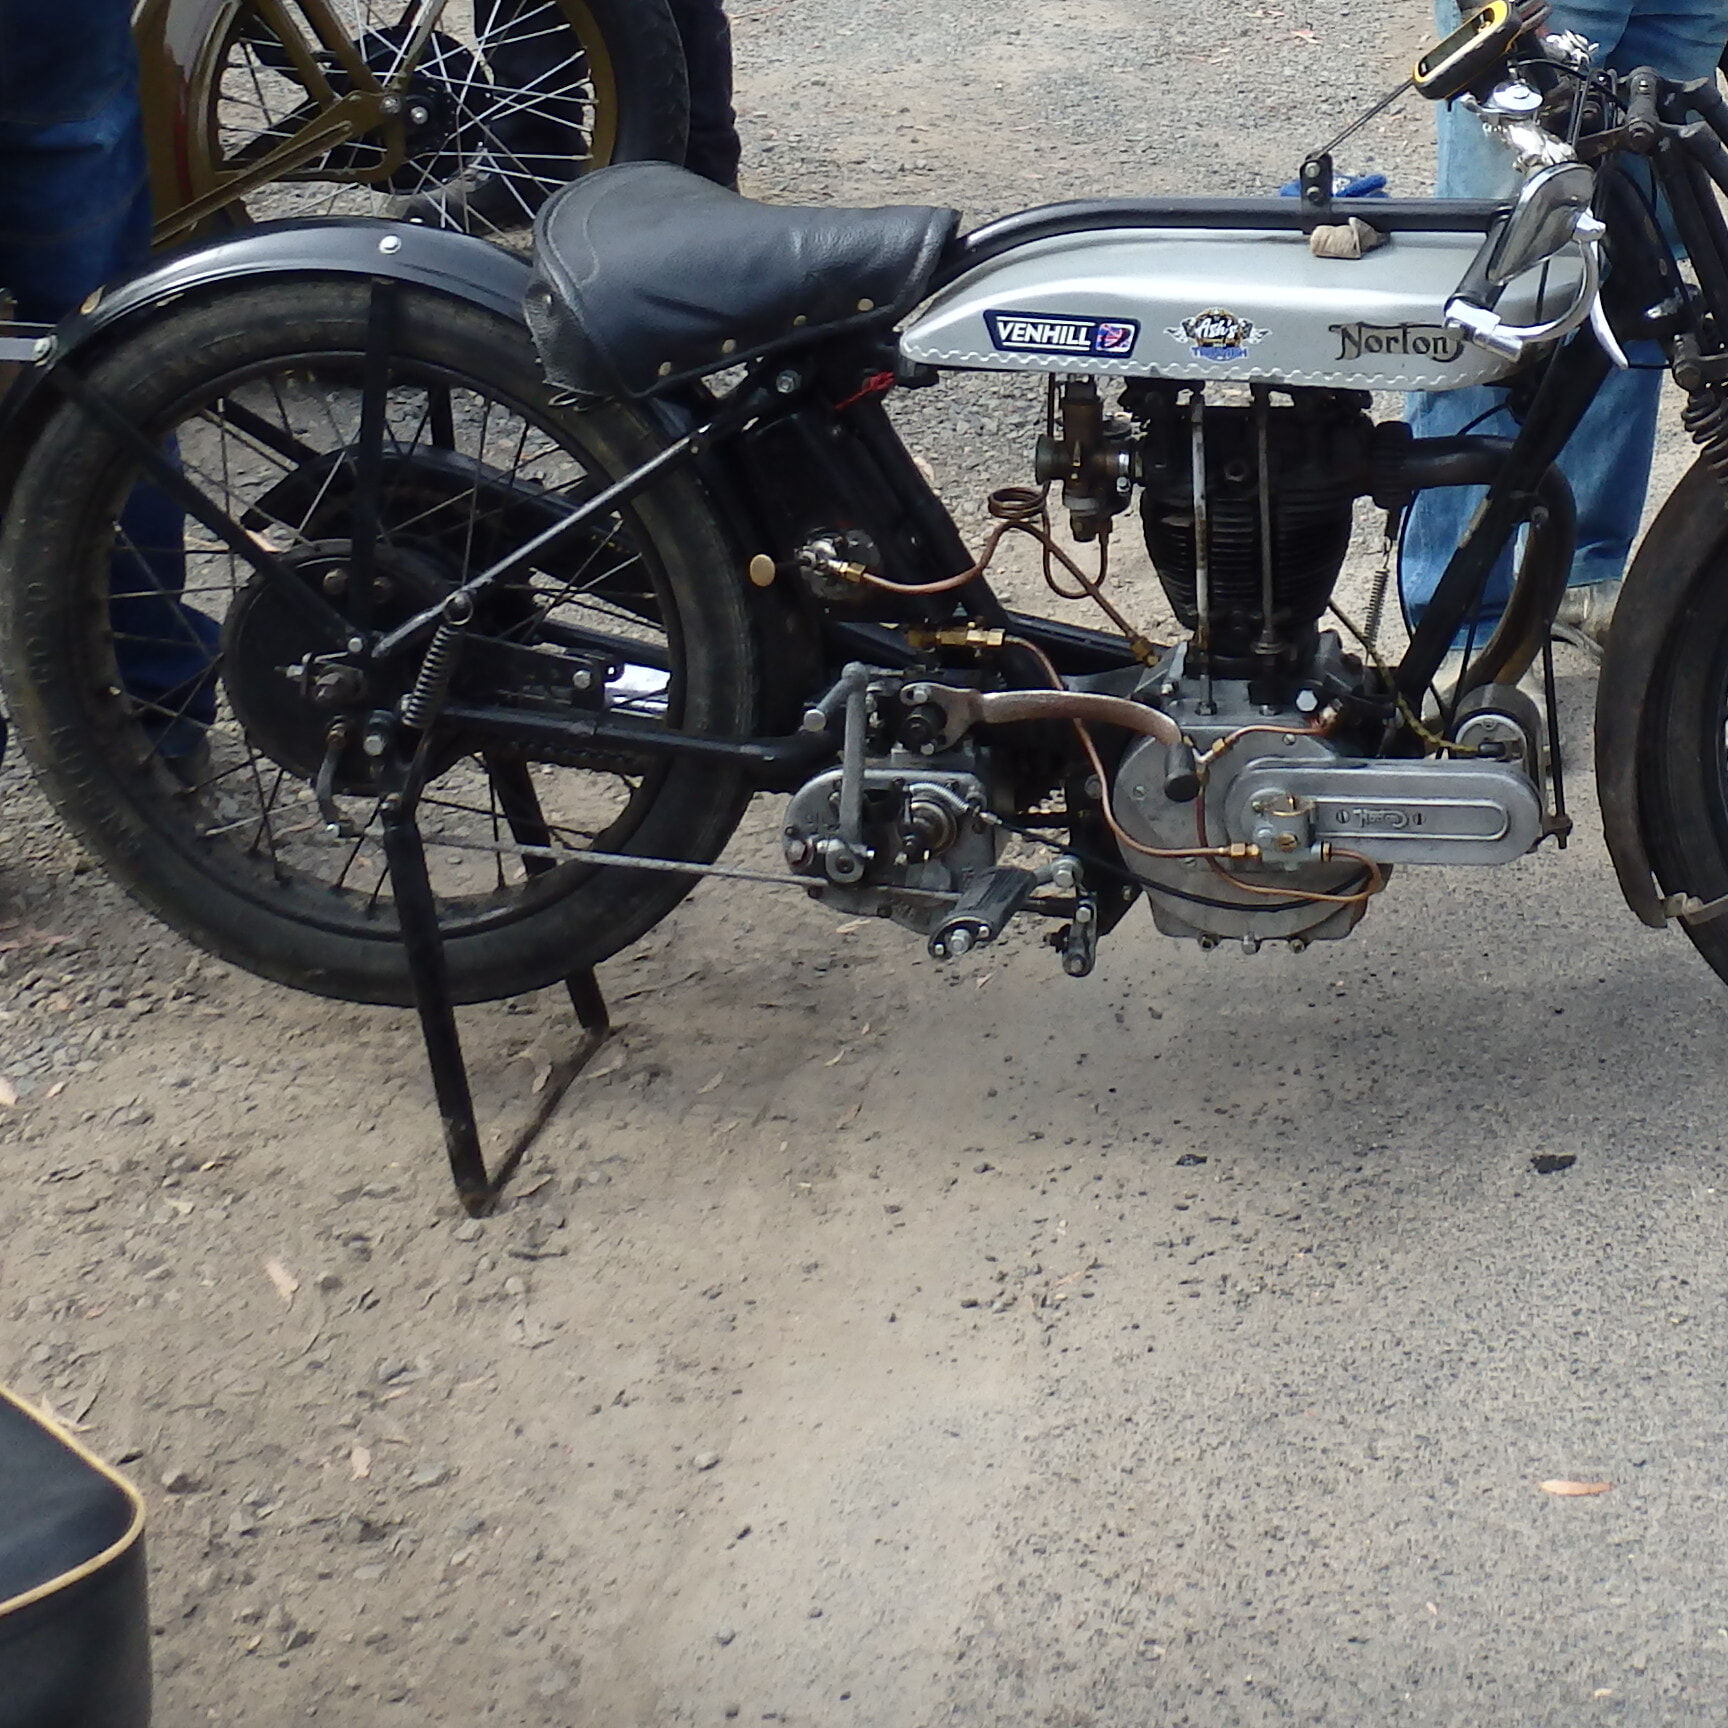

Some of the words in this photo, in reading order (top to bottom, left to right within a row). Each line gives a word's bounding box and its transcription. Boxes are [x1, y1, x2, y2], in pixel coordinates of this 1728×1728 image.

[998, 322, 1092, 346] VENHILL
[1195, 317, 1238, 339] Ash's
[1328, 321, 1465, 363] Norton
